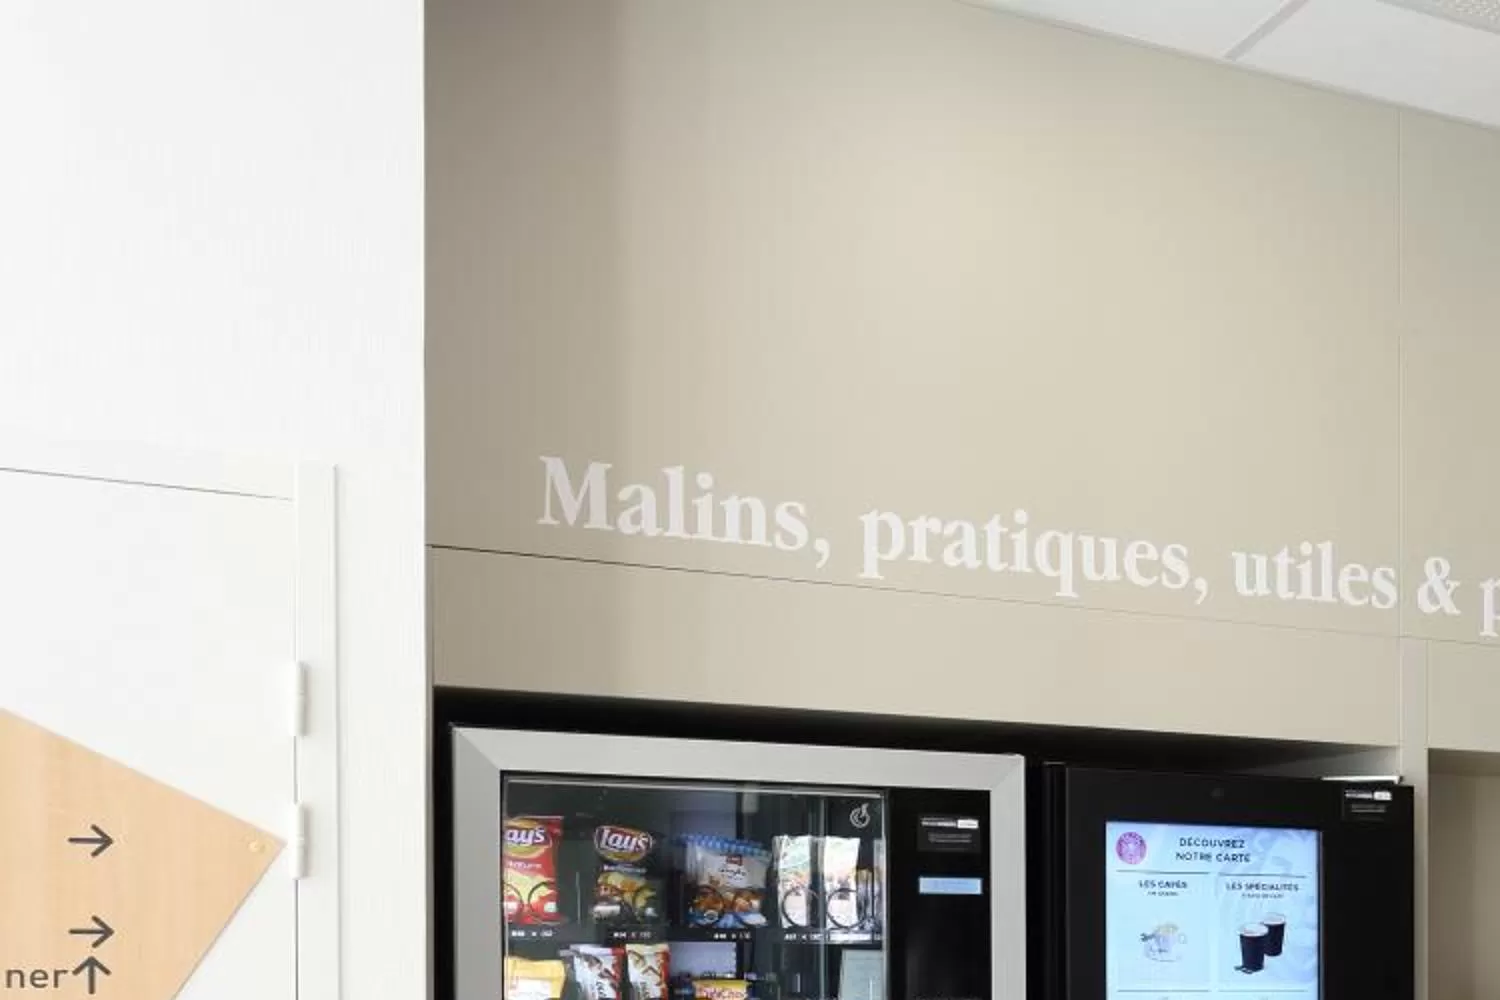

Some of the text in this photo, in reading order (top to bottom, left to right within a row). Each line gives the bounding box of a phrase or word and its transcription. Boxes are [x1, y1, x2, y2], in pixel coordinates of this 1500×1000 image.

[536, 455, 830, 569] Malins,
[857, 509, 1208, 605] pratiques,
[1231, 539, 1398, 609] utiles
[1417, 556, 1462, 616] &
[505, 826, 545, 846] ay's
[601, 828, 649, 852] Lay's
[1175, 852, 1251, 862] NOTRE CARTE
[5, 968, 69, 989] ner
